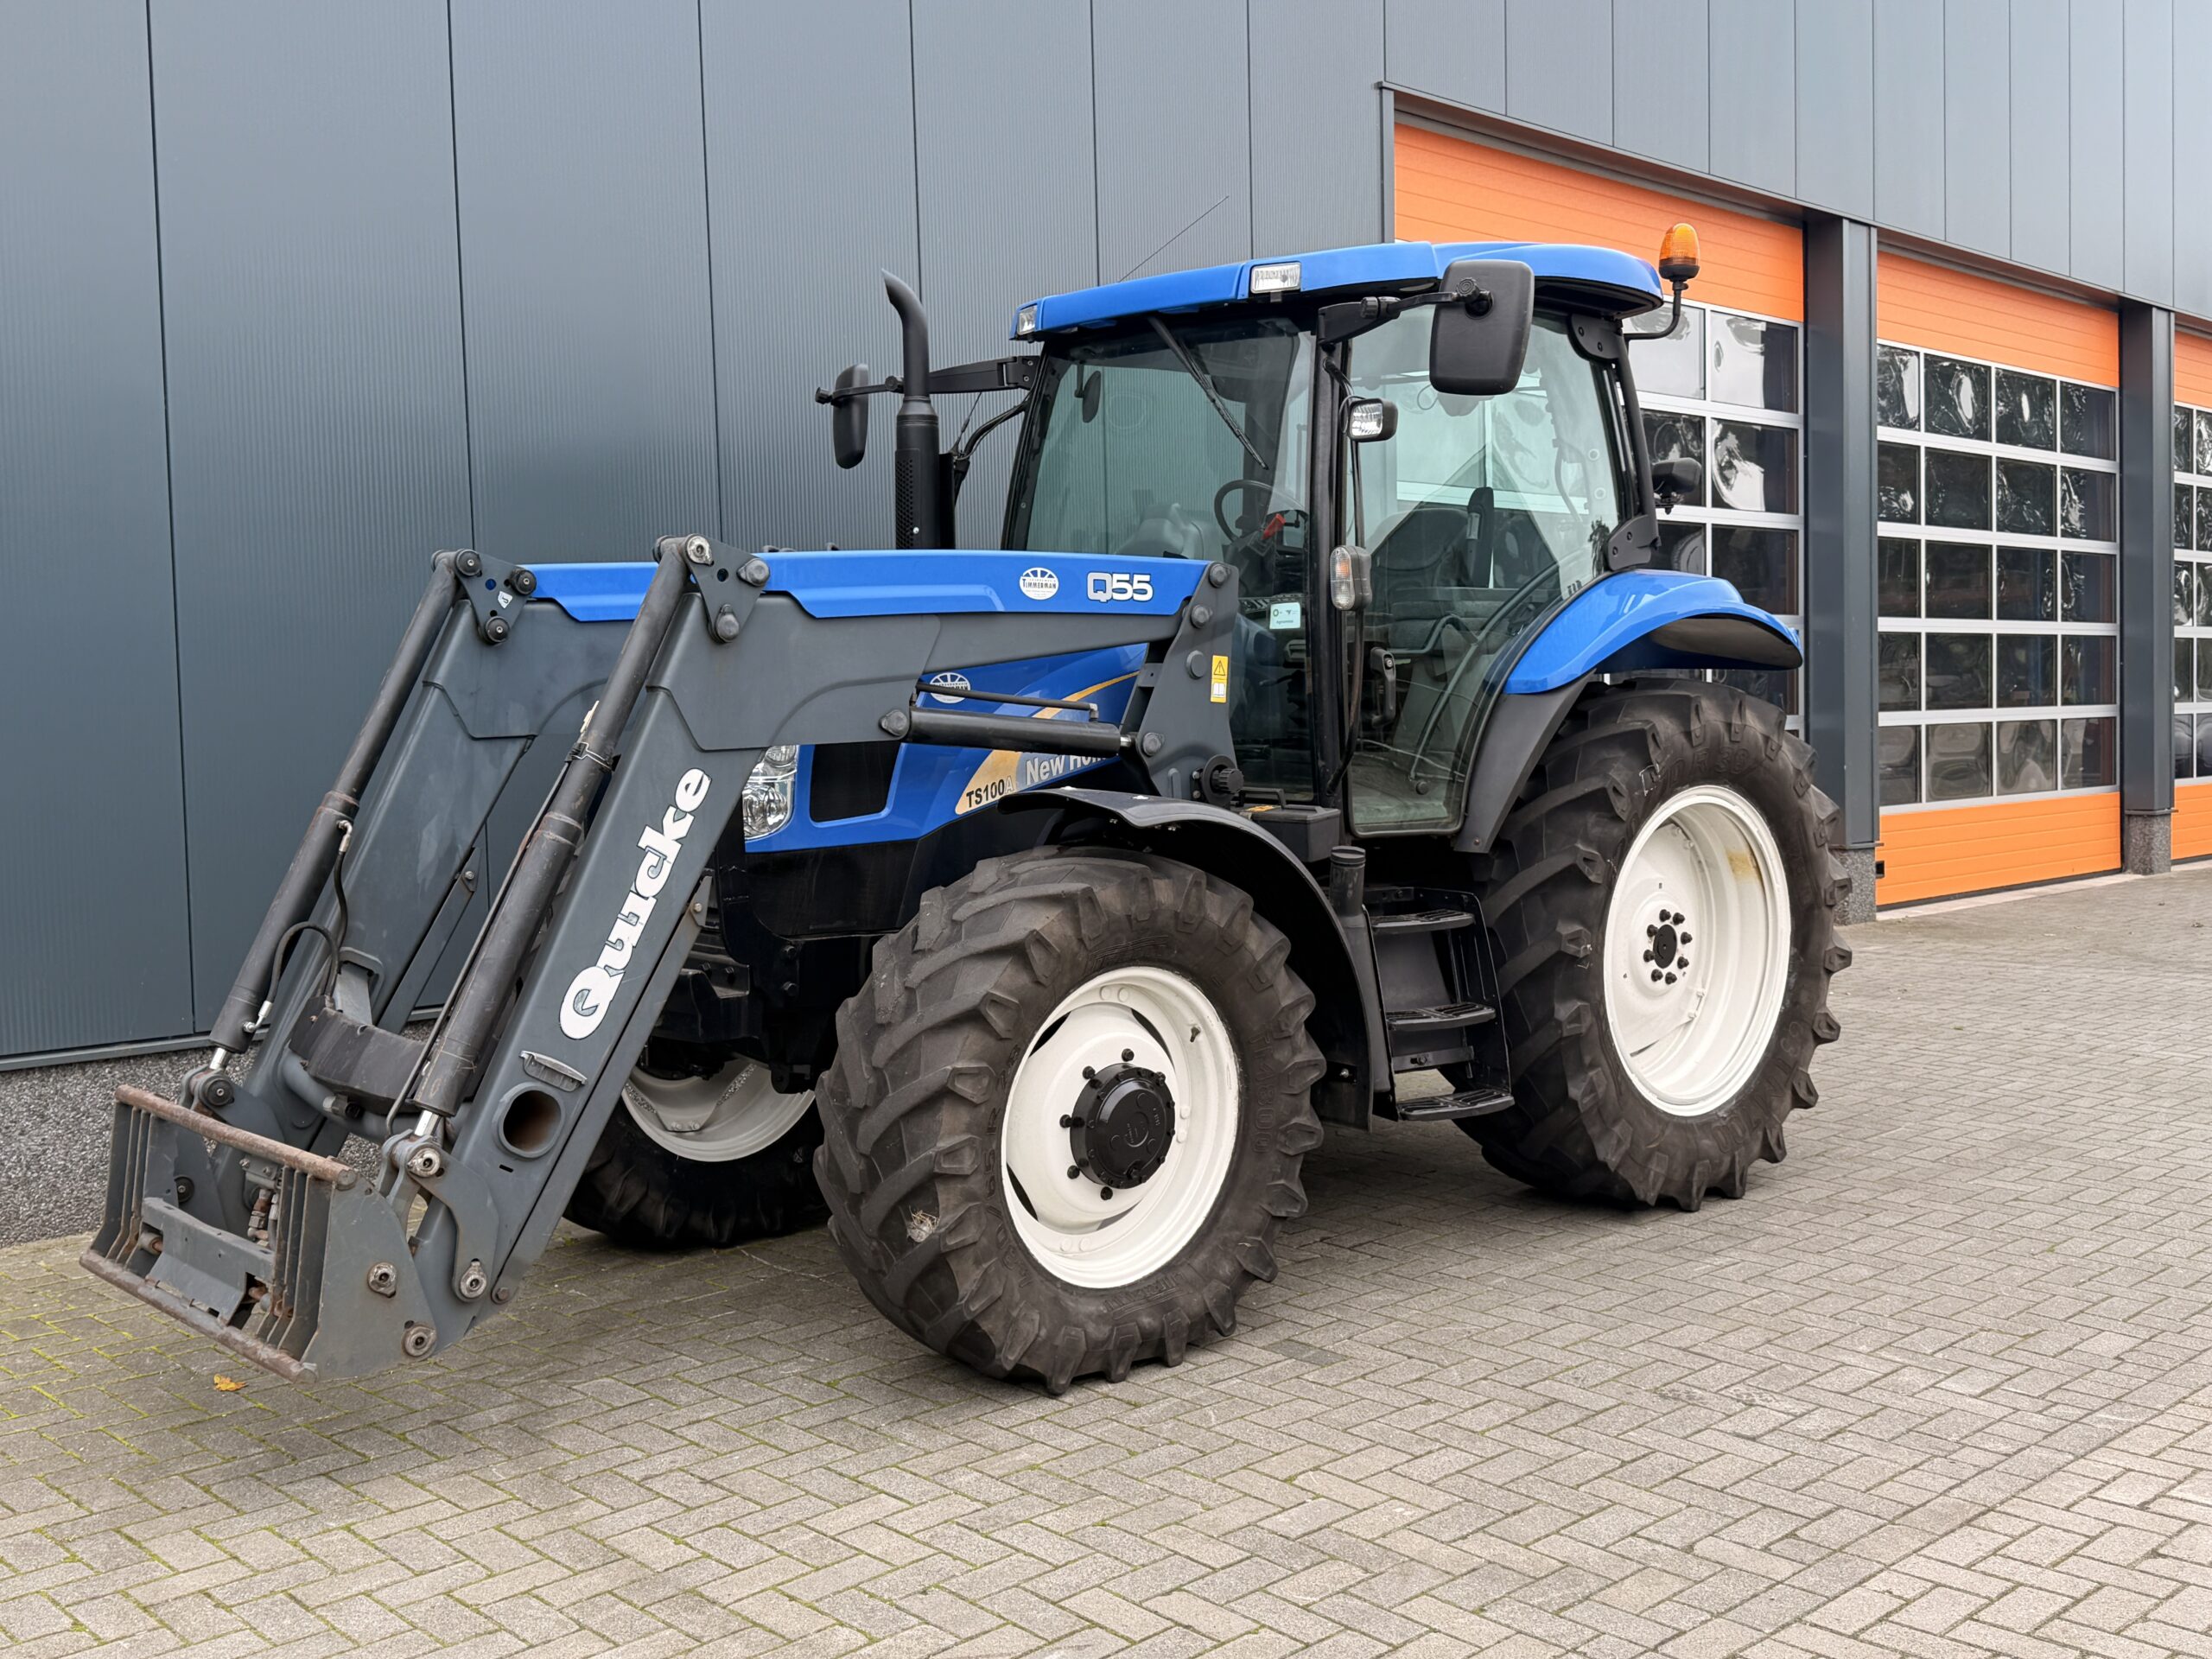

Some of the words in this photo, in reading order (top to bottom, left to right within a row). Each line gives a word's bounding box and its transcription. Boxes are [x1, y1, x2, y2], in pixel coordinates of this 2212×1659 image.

[1022, 578, 1057, 589] TIMMERMAN
[1087, 572, 1154, 602] Q55
[1026, 755, 1065, 786] New
[559, 767, 713, 1040] Quicke
